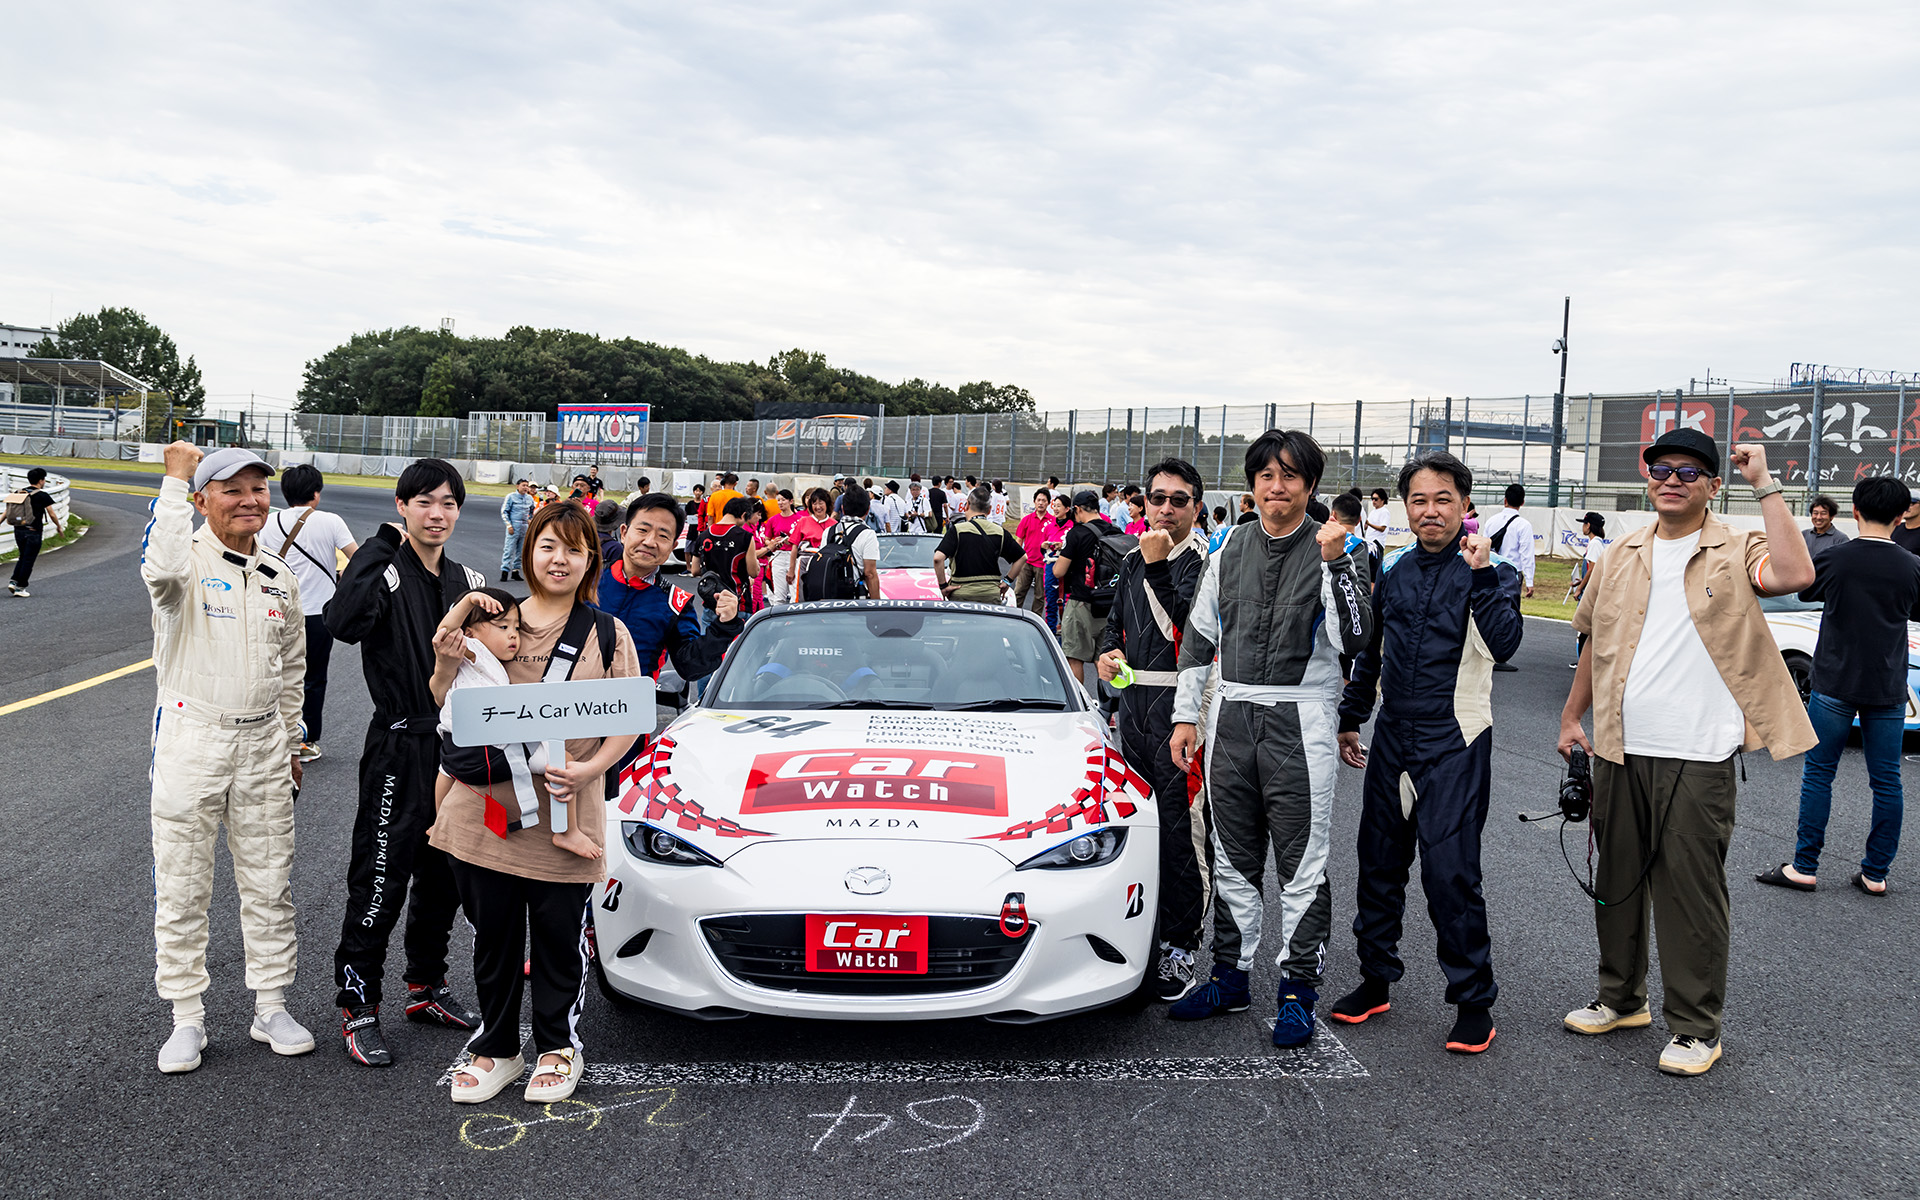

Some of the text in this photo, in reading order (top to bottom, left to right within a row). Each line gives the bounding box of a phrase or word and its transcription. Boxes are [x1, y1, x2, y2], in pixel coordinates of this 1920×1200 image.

[563, 414, 640, 443] WAKO'S
[787, 599, 1007, 613] MAZDA SPIRIT RACING
[512, 654, 550, 663] ATE THA
[798, 647, 843, 656] BRIDE
[482, 699, 628, 723] チーム Car Watch
[722, 715, 832, 738] 64
[866, 731, 948, 739] Ishikawa
[970, 729, 1036, 739] Takashi
[865, 738, 1034, 754] Kawakami Kanata
[775, 752, 979, 779] Car
[802, 780, 949, 802] Watch
[826, 818, 919, 829] MAZDA
[361, 774, 396, 928] MAZDA SPIRIT RACING
[823, 921, 911, 949] Car
[836, 951, 899, 969] Watch
[807, 1094, 984, 1153] 64
